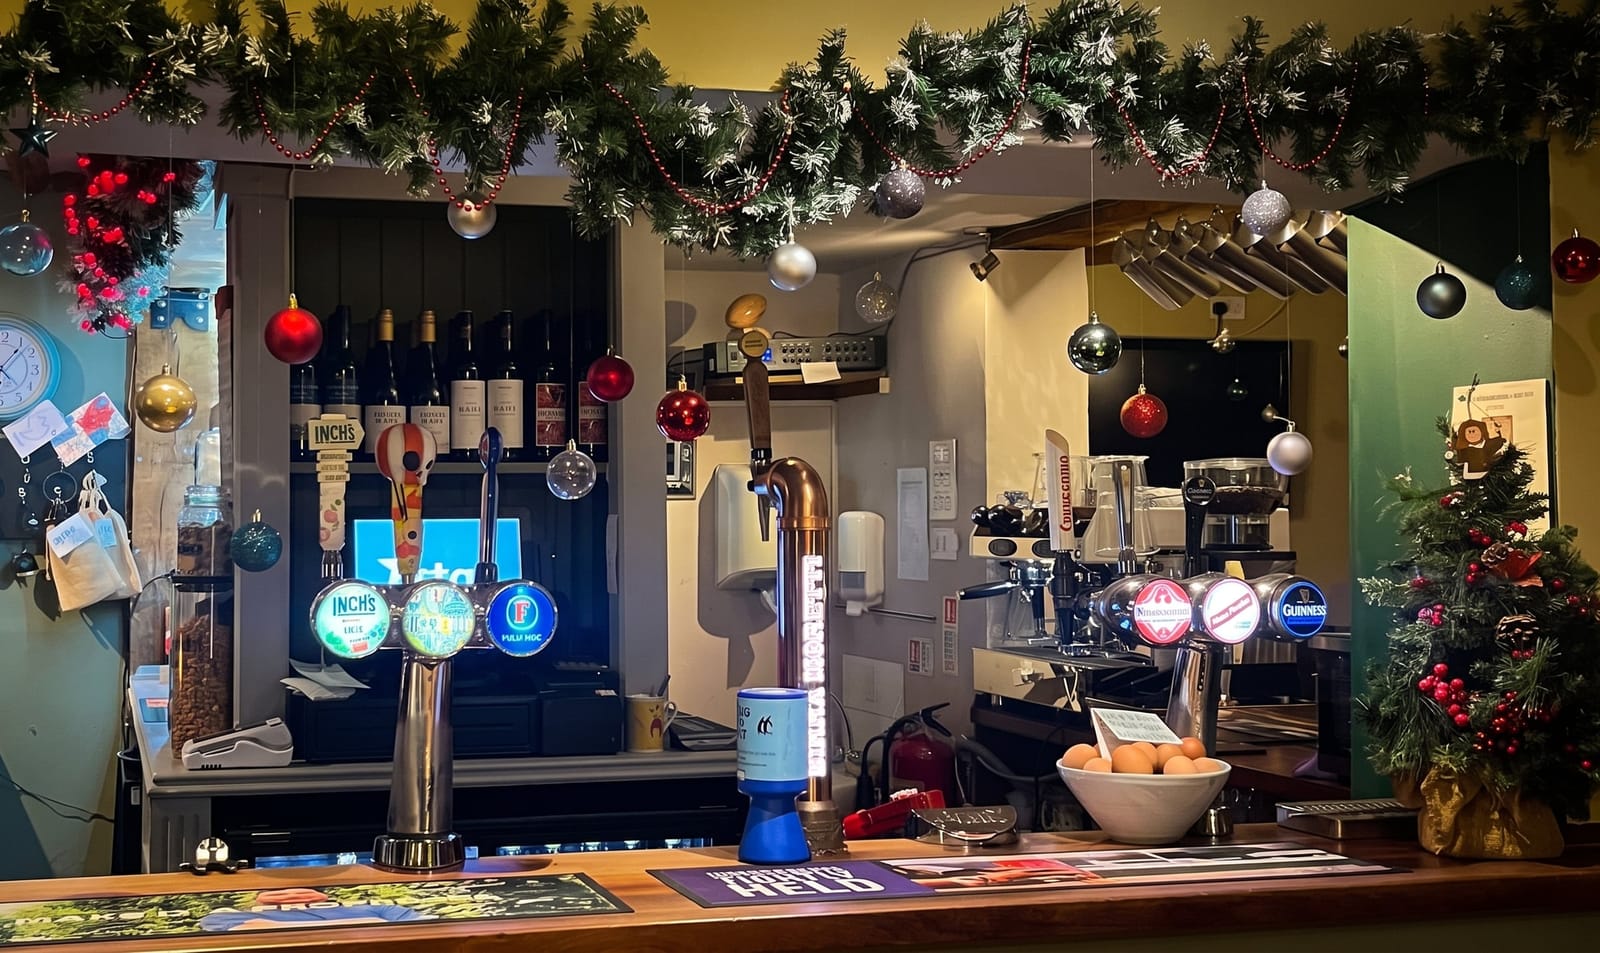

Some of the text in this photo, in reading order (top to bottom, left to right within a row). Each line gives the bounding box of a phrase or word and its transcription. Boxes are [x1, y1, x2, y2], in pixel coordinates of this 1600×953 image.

[31, 365, 40, 376] 3
[1283, 603, 1327, 617] GUINNESS
[726, 878, 885, 897] HELD
